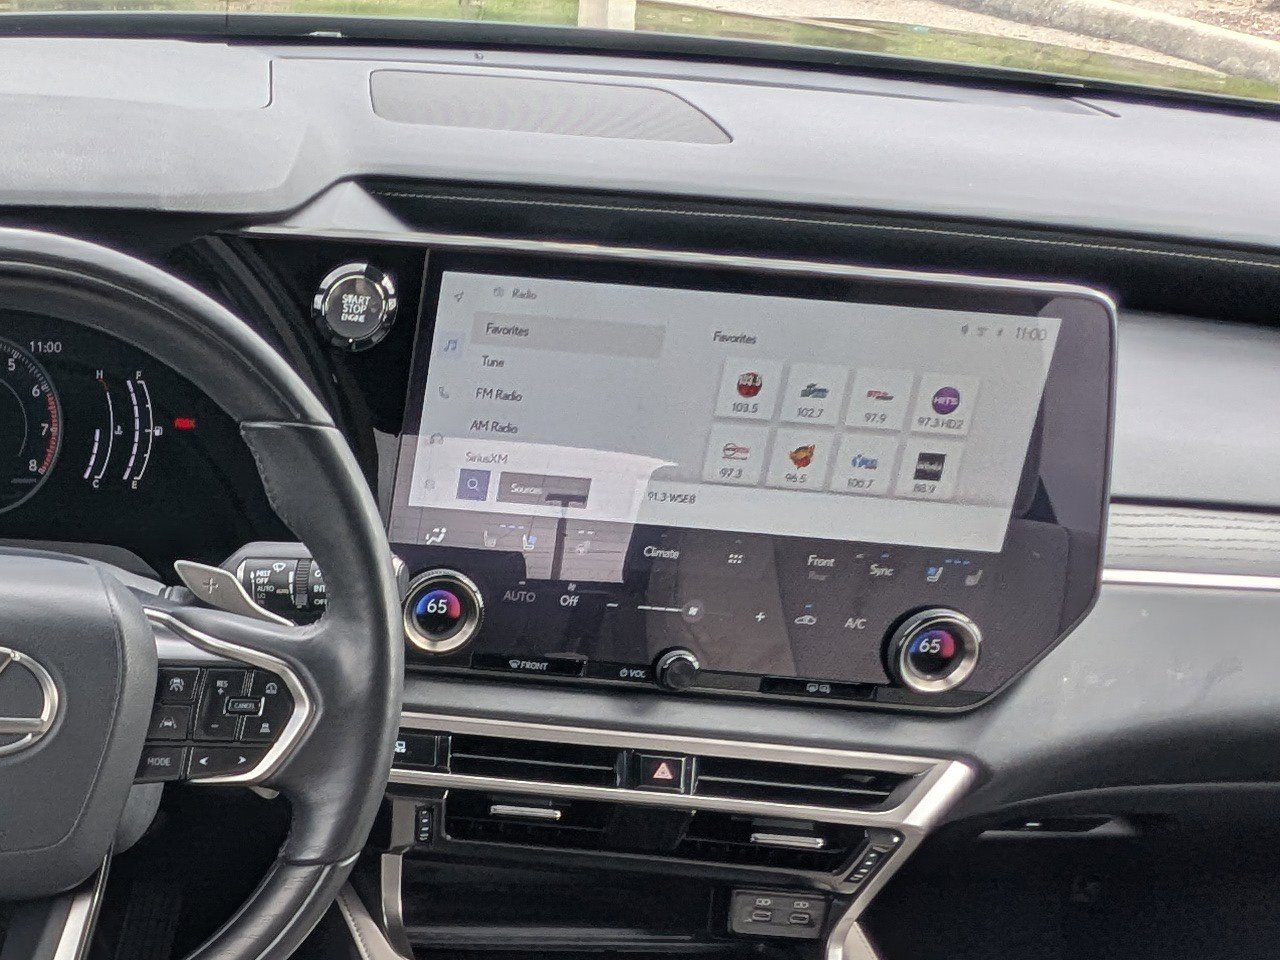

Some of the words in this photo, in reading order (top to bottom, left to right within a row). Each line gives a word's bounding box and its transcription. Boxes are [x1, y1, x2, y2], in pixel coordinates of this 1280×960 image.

[342, 294, 371, 305] START
[512, 288, 538, 300] Radio
[342, 304, 367, 314] STOP
[485, 322, 529, 337] Favorites
[713, 331, 757, 344] Favorites
[29, 341, 62, 353] 11:00
[7, 358, 16, 371] 5
[482, 355, 505, 367] Tune
[96, 370, 103, 379] H
[31, 385, 40, 397] 6
[476, 387, 493, 399] FM
[495, 389, 523, 401] Radio
[732, 402, 759, 413] 103.5
[797, 407, 824, 418] 102.7
[865, 412, 887, 424] 97.9
[41, 423, 49, 436] 7
[470, 420, 489, 431] AM
[491, 421, 518, 434] Radio
[465, 452, 508, 464] SiriusXM
[28, 459, 37, 472] 8
[92, 480, 99, 488] C
[131, 481, 138, 489] E
[644, 545, 680, 560] Climate
[807, 555, 835, 567] Front
[870, 564, 894, 576] Sync
[503, 590, 536, 602] AUTO
[560, 595, 580, 607] Off
[427, 599, 448, 614] 65
[844, 617, 867, 629] A/C
[919, 638, 941, 653] 65
[520, 662, 548, 671] FRONT
[629, 669, 647, 678] VOL
[147, 757, 170, 767] MODE
